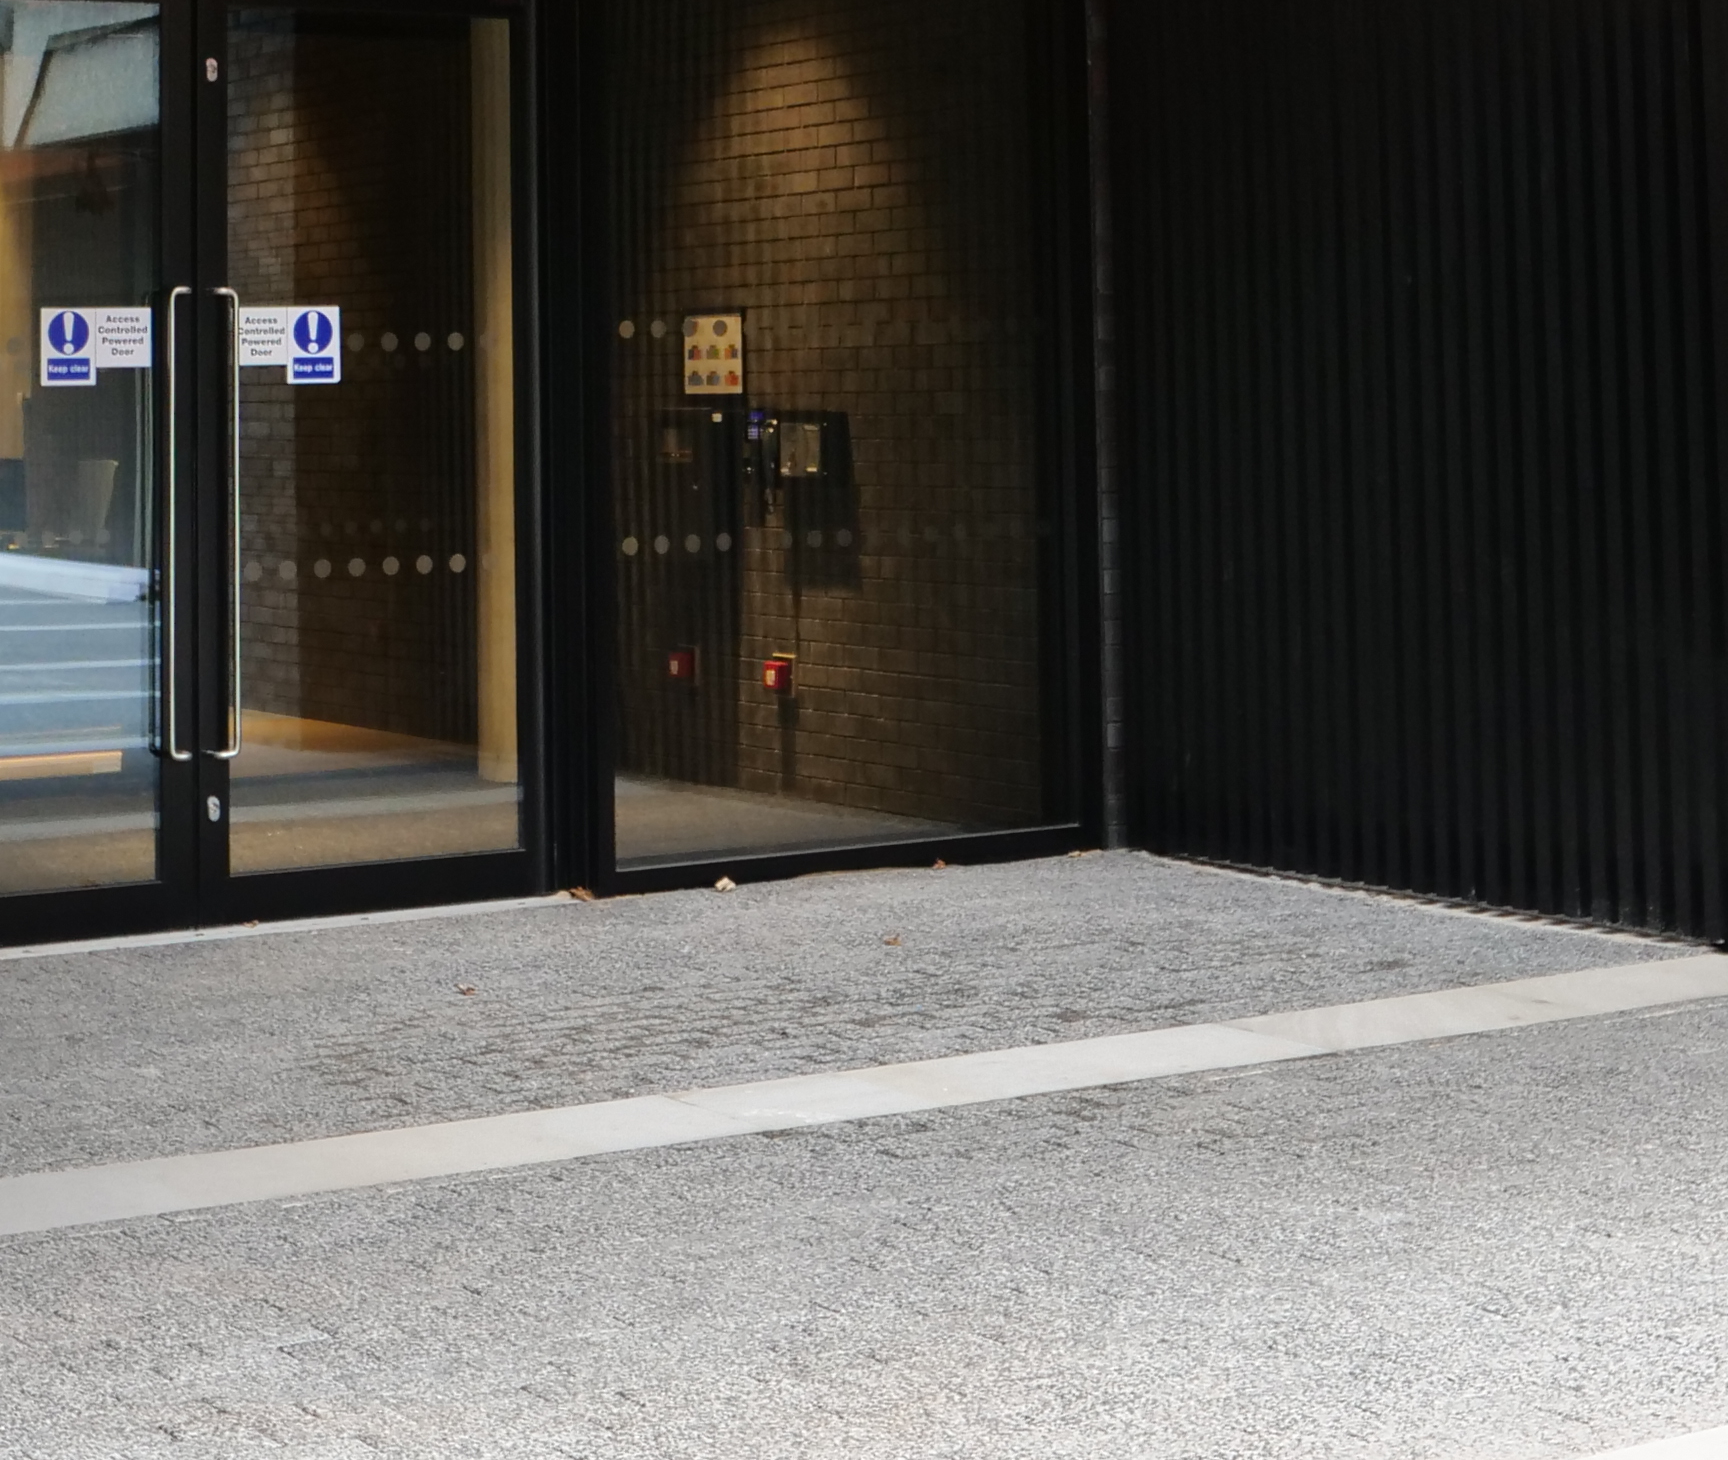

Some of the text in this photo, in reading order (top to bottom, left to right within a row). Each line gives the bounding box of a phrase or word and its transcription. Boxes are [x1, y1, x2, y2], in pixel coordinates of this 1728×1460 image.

[105, 314, 140, 323] Access
[244, 316, 278, 325] Access
[97, 325, 148, 334] Controlled
[101, 336, 145, 345] Powered
[241, 337, 282, 346] Powered
[111, 347, 134, 356] Door
[250, 348, 273, 357] Door
[48, 364, 89, 375] Keep clear
[294, 363, 333, 374] Keep clear
